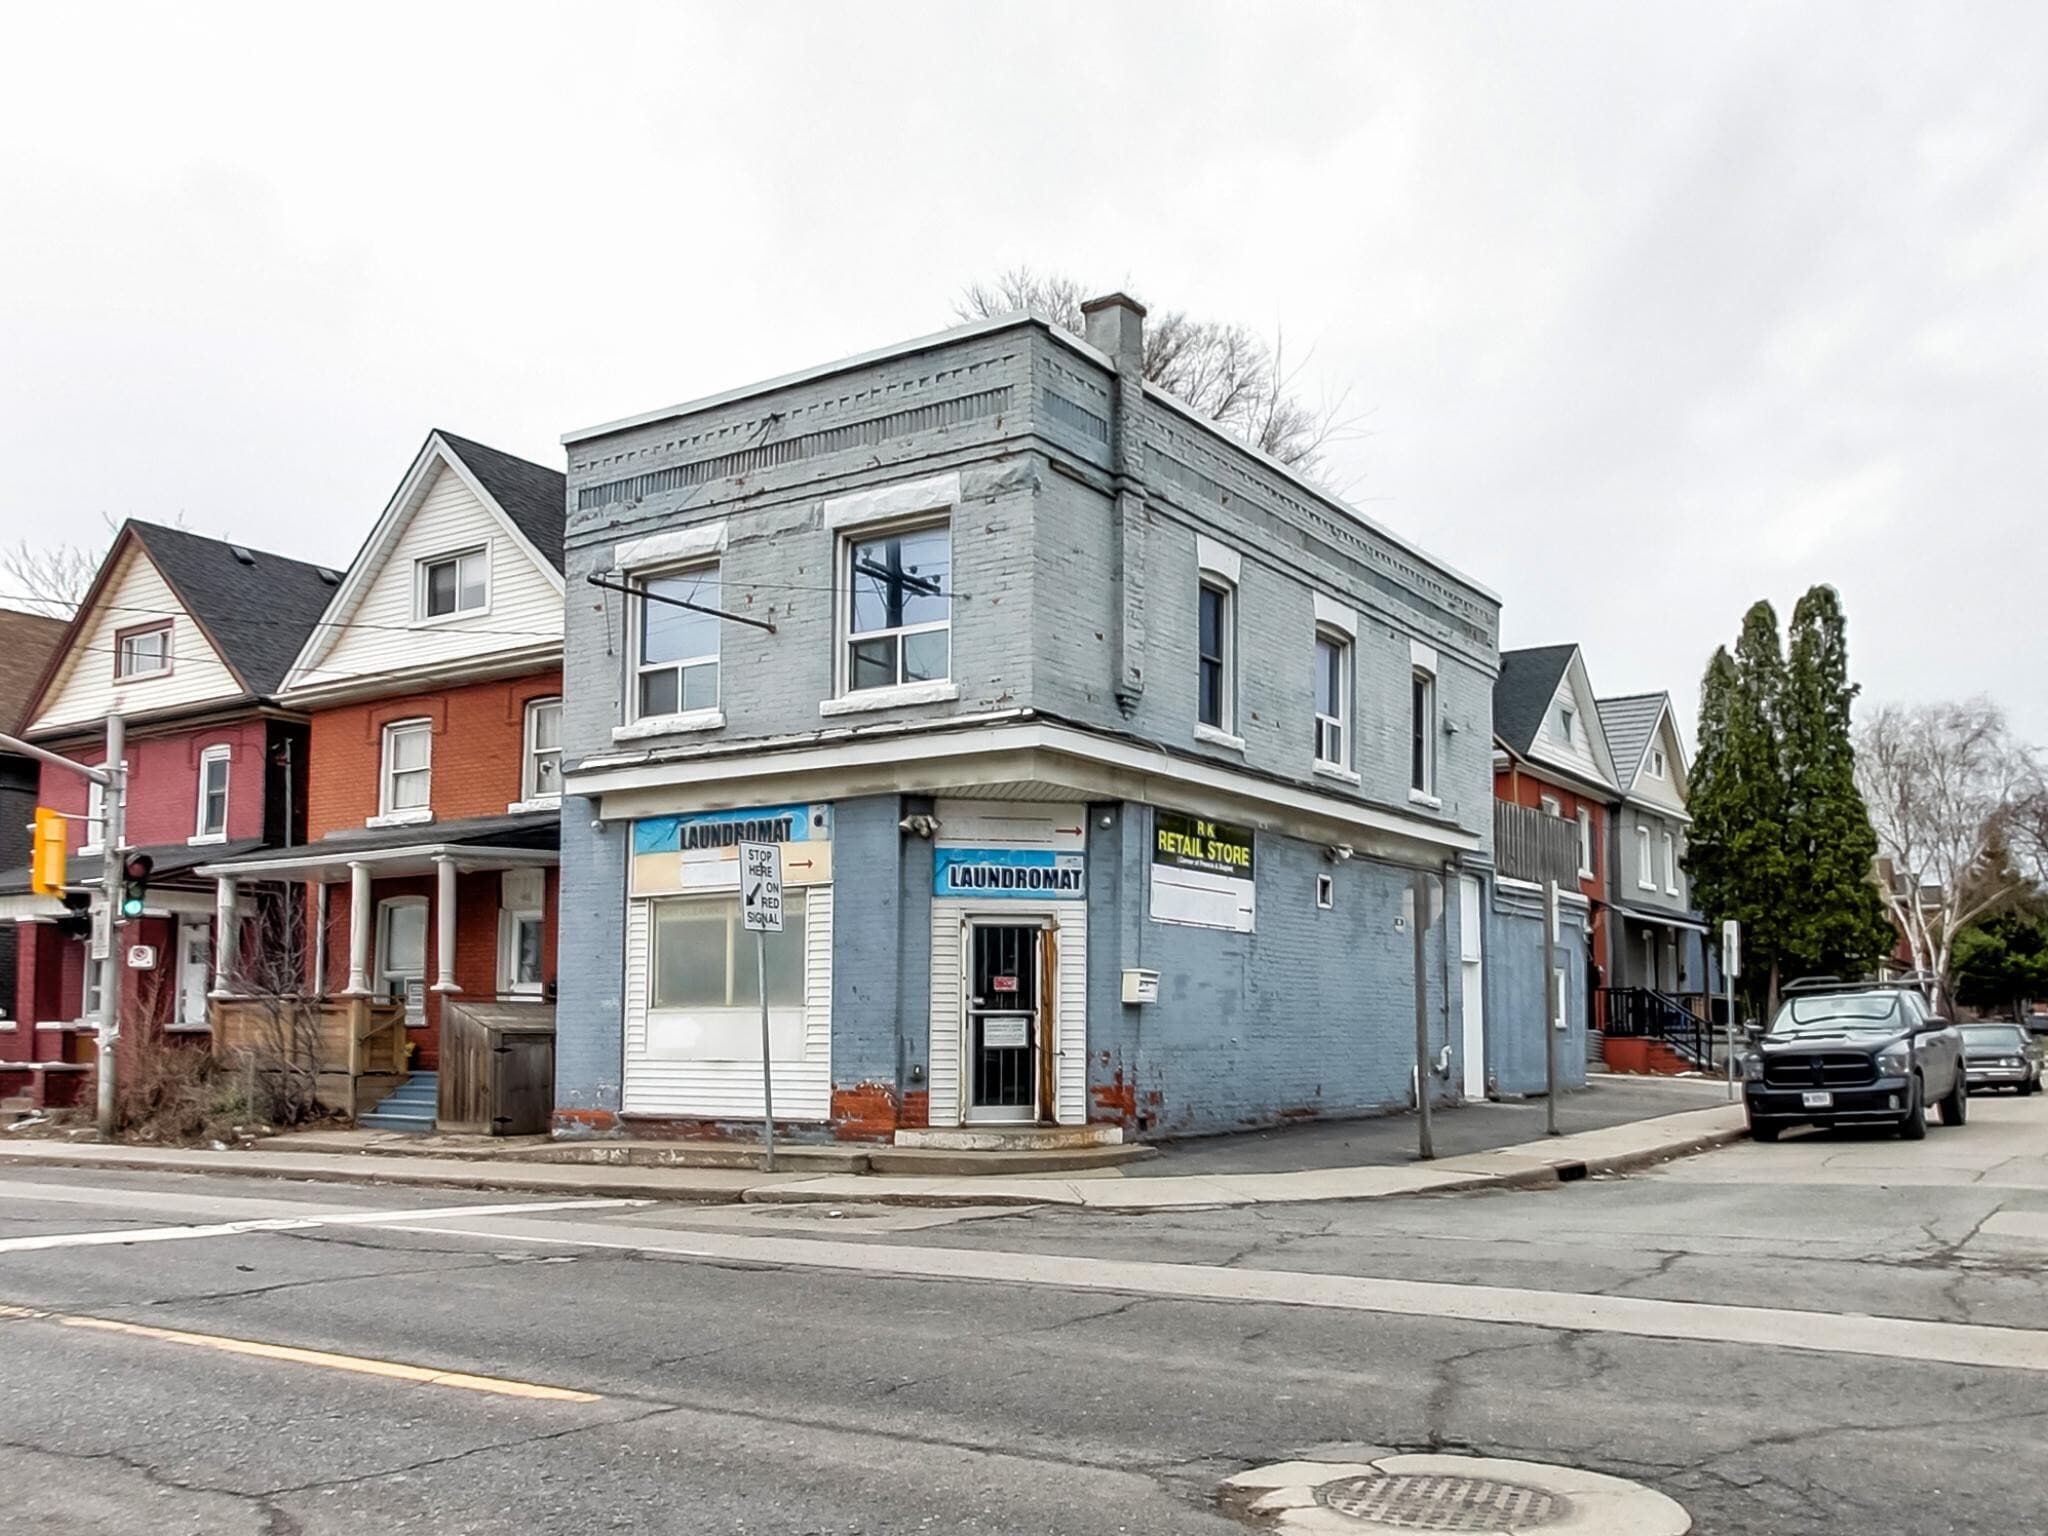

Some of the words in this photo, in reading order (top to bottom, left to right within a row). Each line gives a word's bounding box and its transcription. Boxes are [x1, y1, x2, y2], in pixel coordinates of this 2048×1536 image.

[680, 818, 793, 850] LAUNDROMAT
[1158, 830, 1204, 858] RETAIL
[1207, 841, 1250, 867] STORE
[748, 849, 772, 862] STOP
[749, 865, 773, 878] HERE
[950, 866, 1083, 890] LAUNDROMAT
[766, 881, 779, 893] ON
[761, 897, 780, 909] RED
[747, 911, 779, 925] SIGNAL
